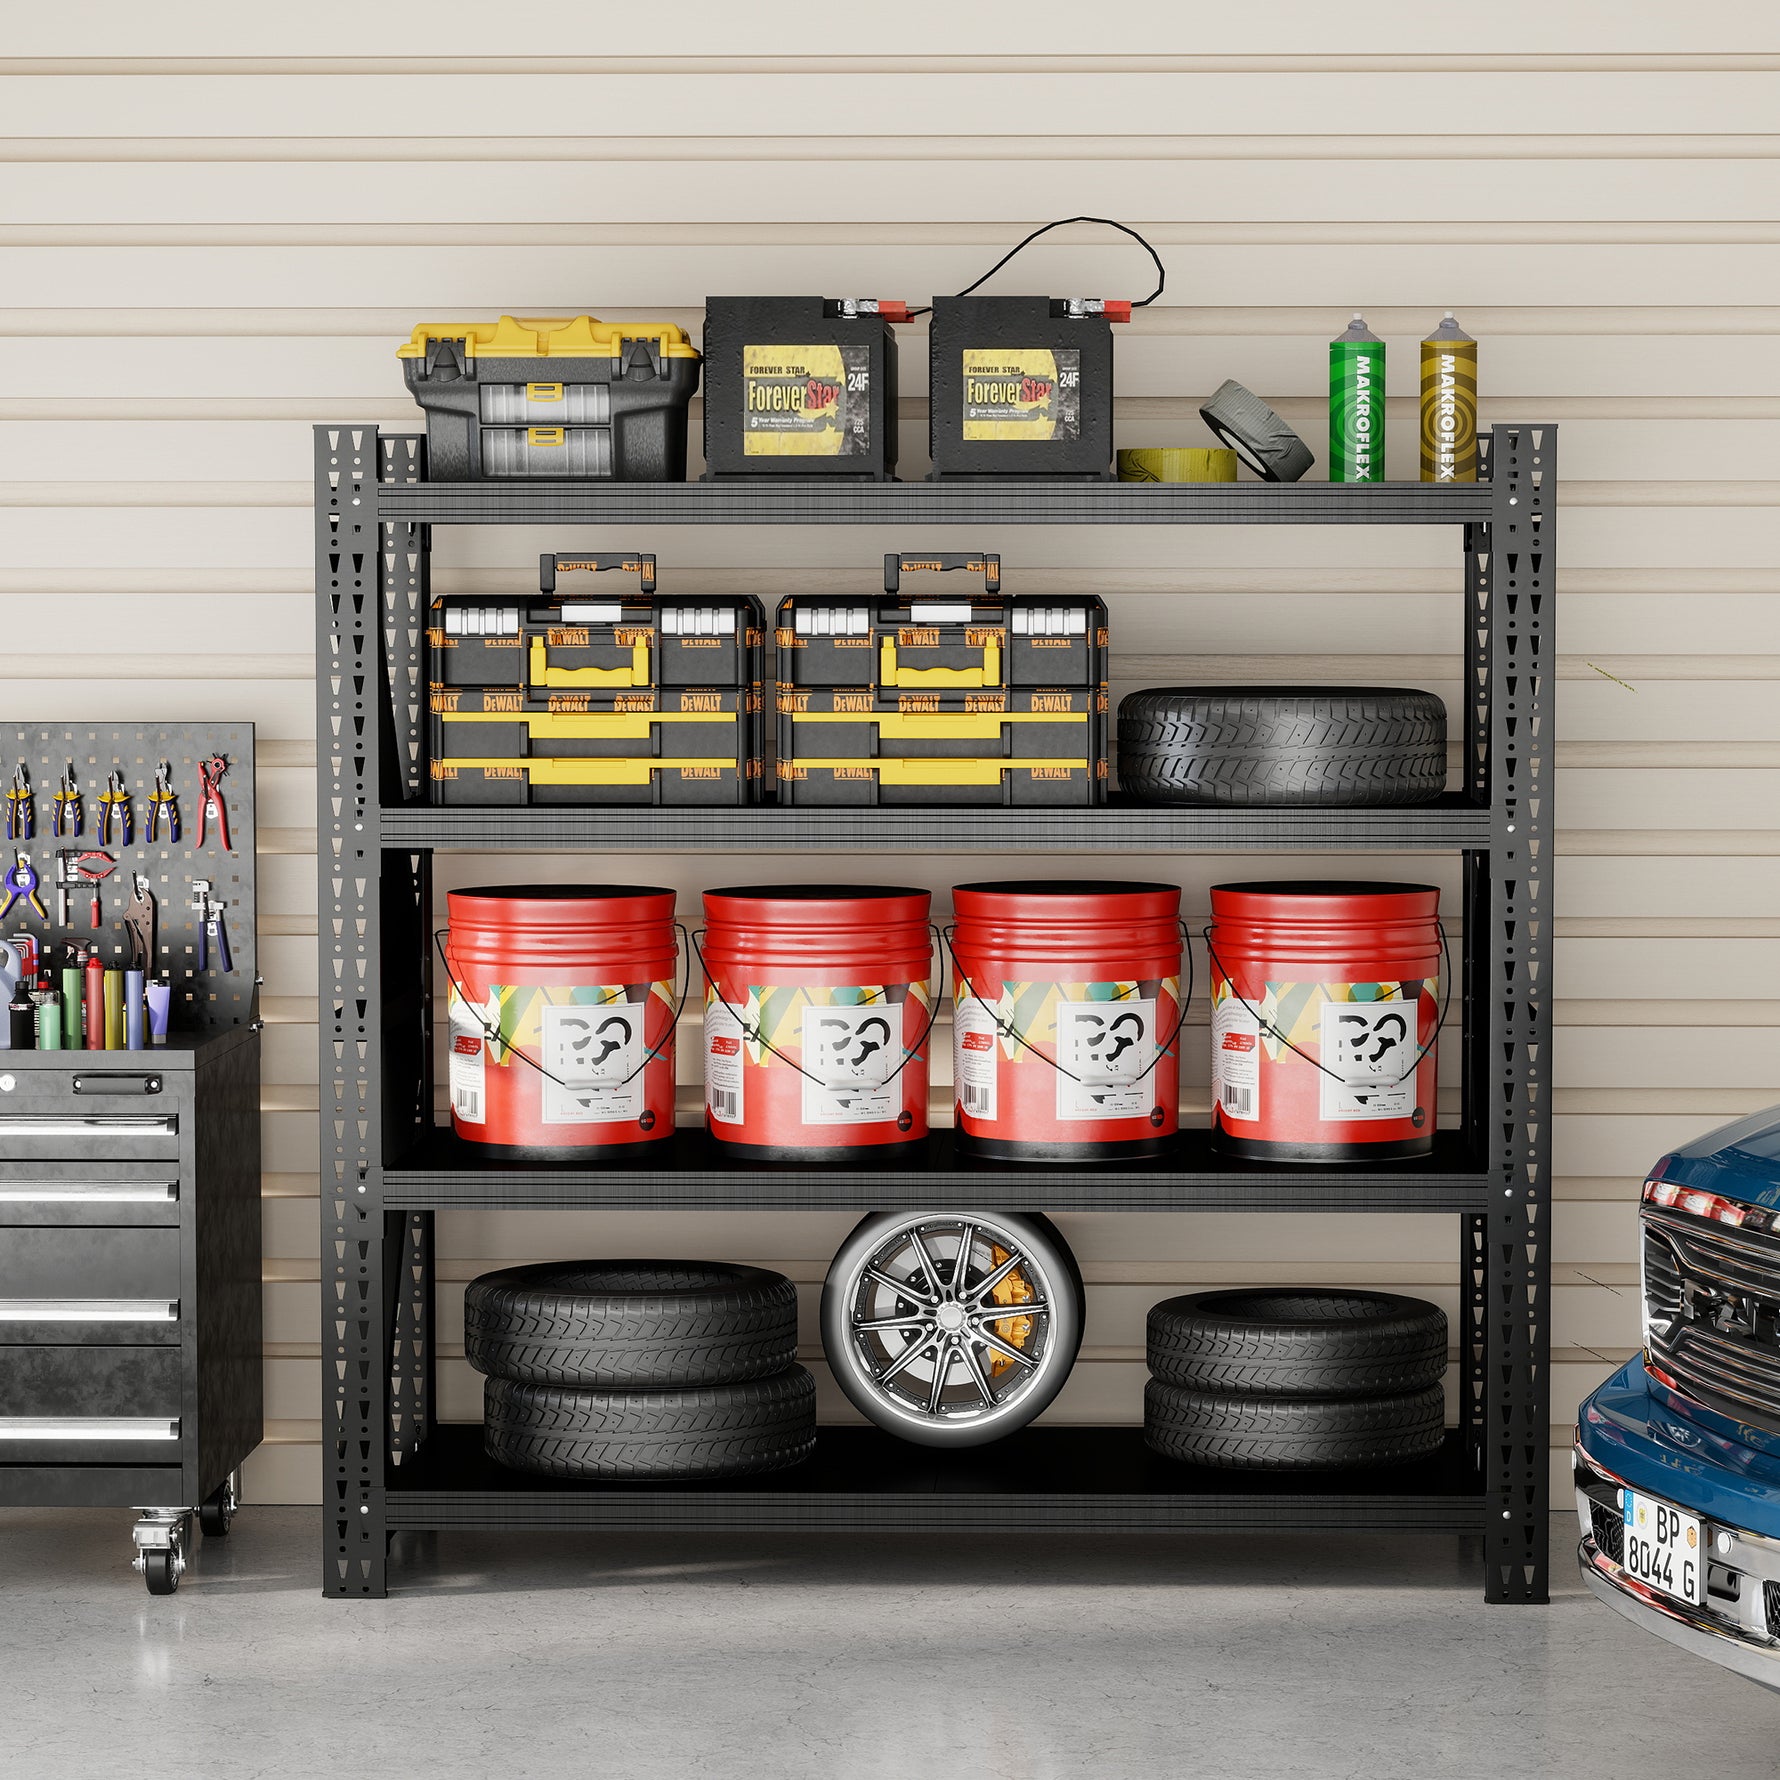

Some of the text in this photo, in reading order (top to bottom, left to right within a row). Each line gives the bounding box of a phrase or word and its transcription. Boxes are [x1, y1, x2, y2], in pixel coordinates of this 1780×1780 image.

[750, 366, 806, 375] FOREVER STAR
[969, 366, 1021, 374] FOREVER STAR
[847, 372, 869, 392] 24F
[1059, 371, 1079, 388] 24F
[751, 416, 758, 428] 5
[969, 408, 976, 418] 5
[1356, 355, 1371, 480] MAKROFLEX
[1440, 354, 1456, 480] MAKROFLEX
[853, 425, 865, 434] CCA
[1657, 1505, 1680, 1549] BP
[1629, 1535, 1673, 1590] 8044
[1684, 1559, 1694, 1600] G
